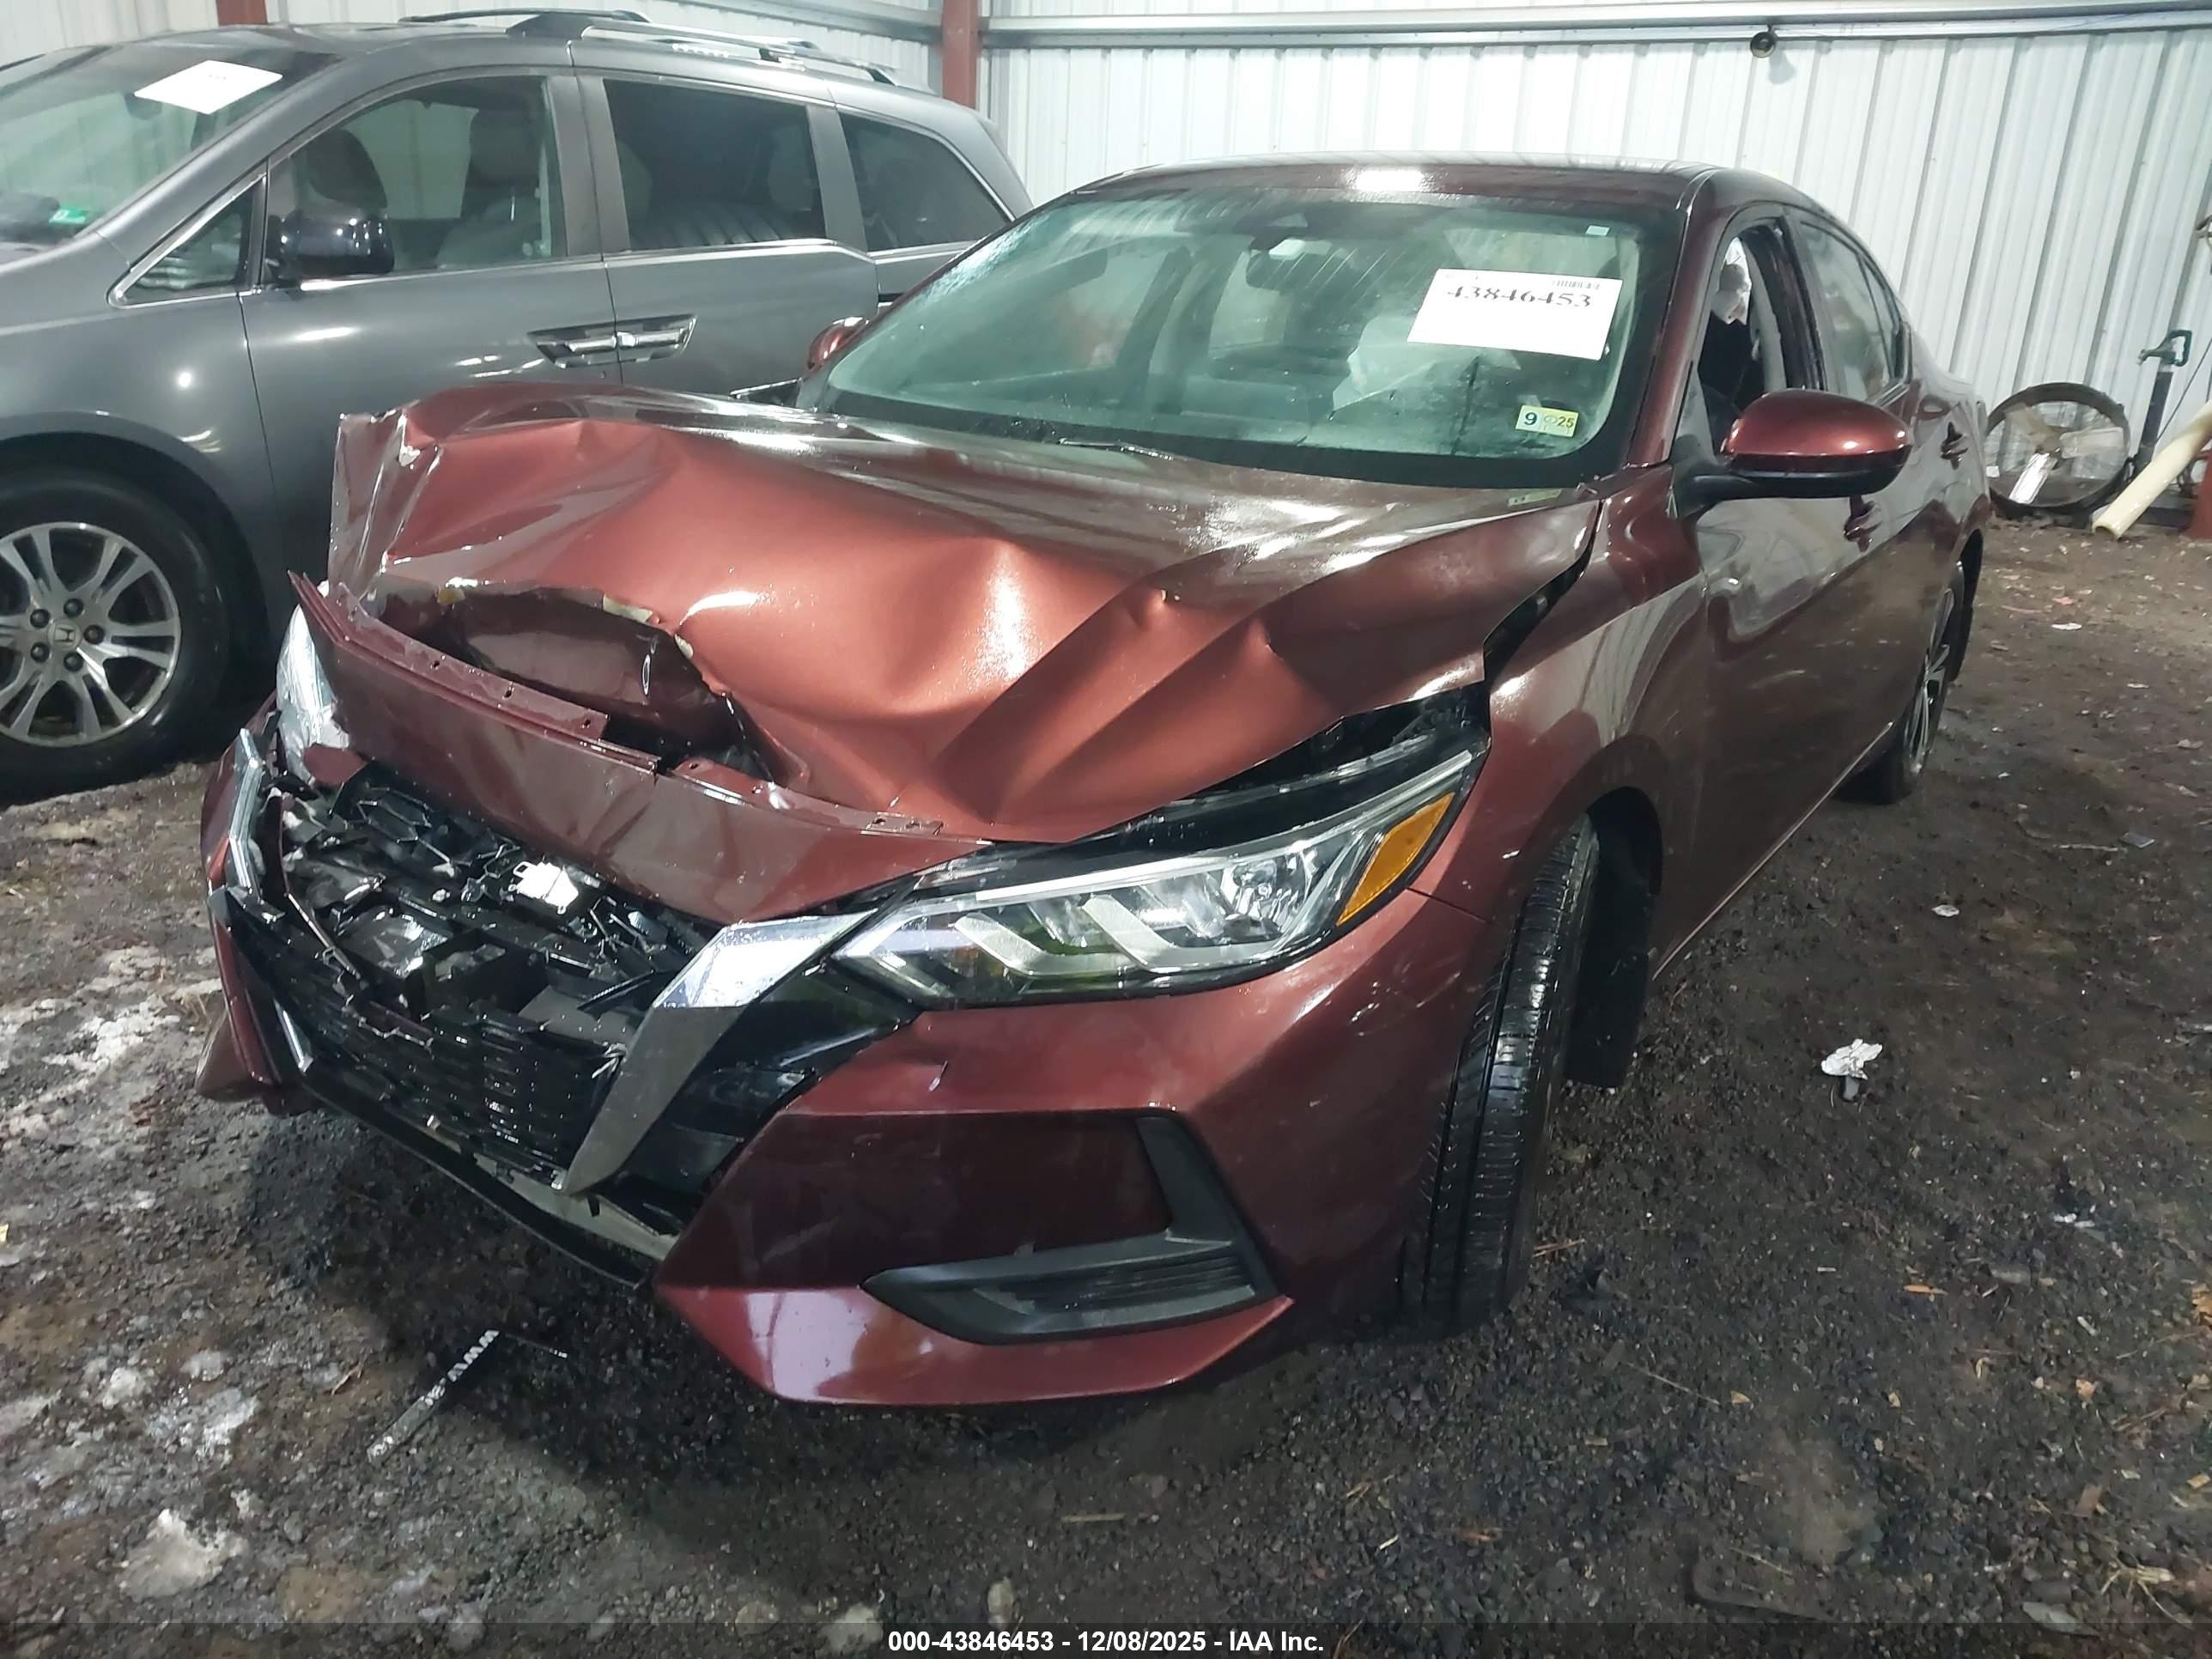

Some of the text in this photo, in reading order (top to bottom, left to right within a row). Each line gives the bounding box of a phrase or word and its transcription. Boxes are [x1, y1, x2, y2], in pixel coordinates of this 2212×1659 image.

[1446, 285, 1593, 308] 43846453
[1523, 411, 1576, 428] 9 25
